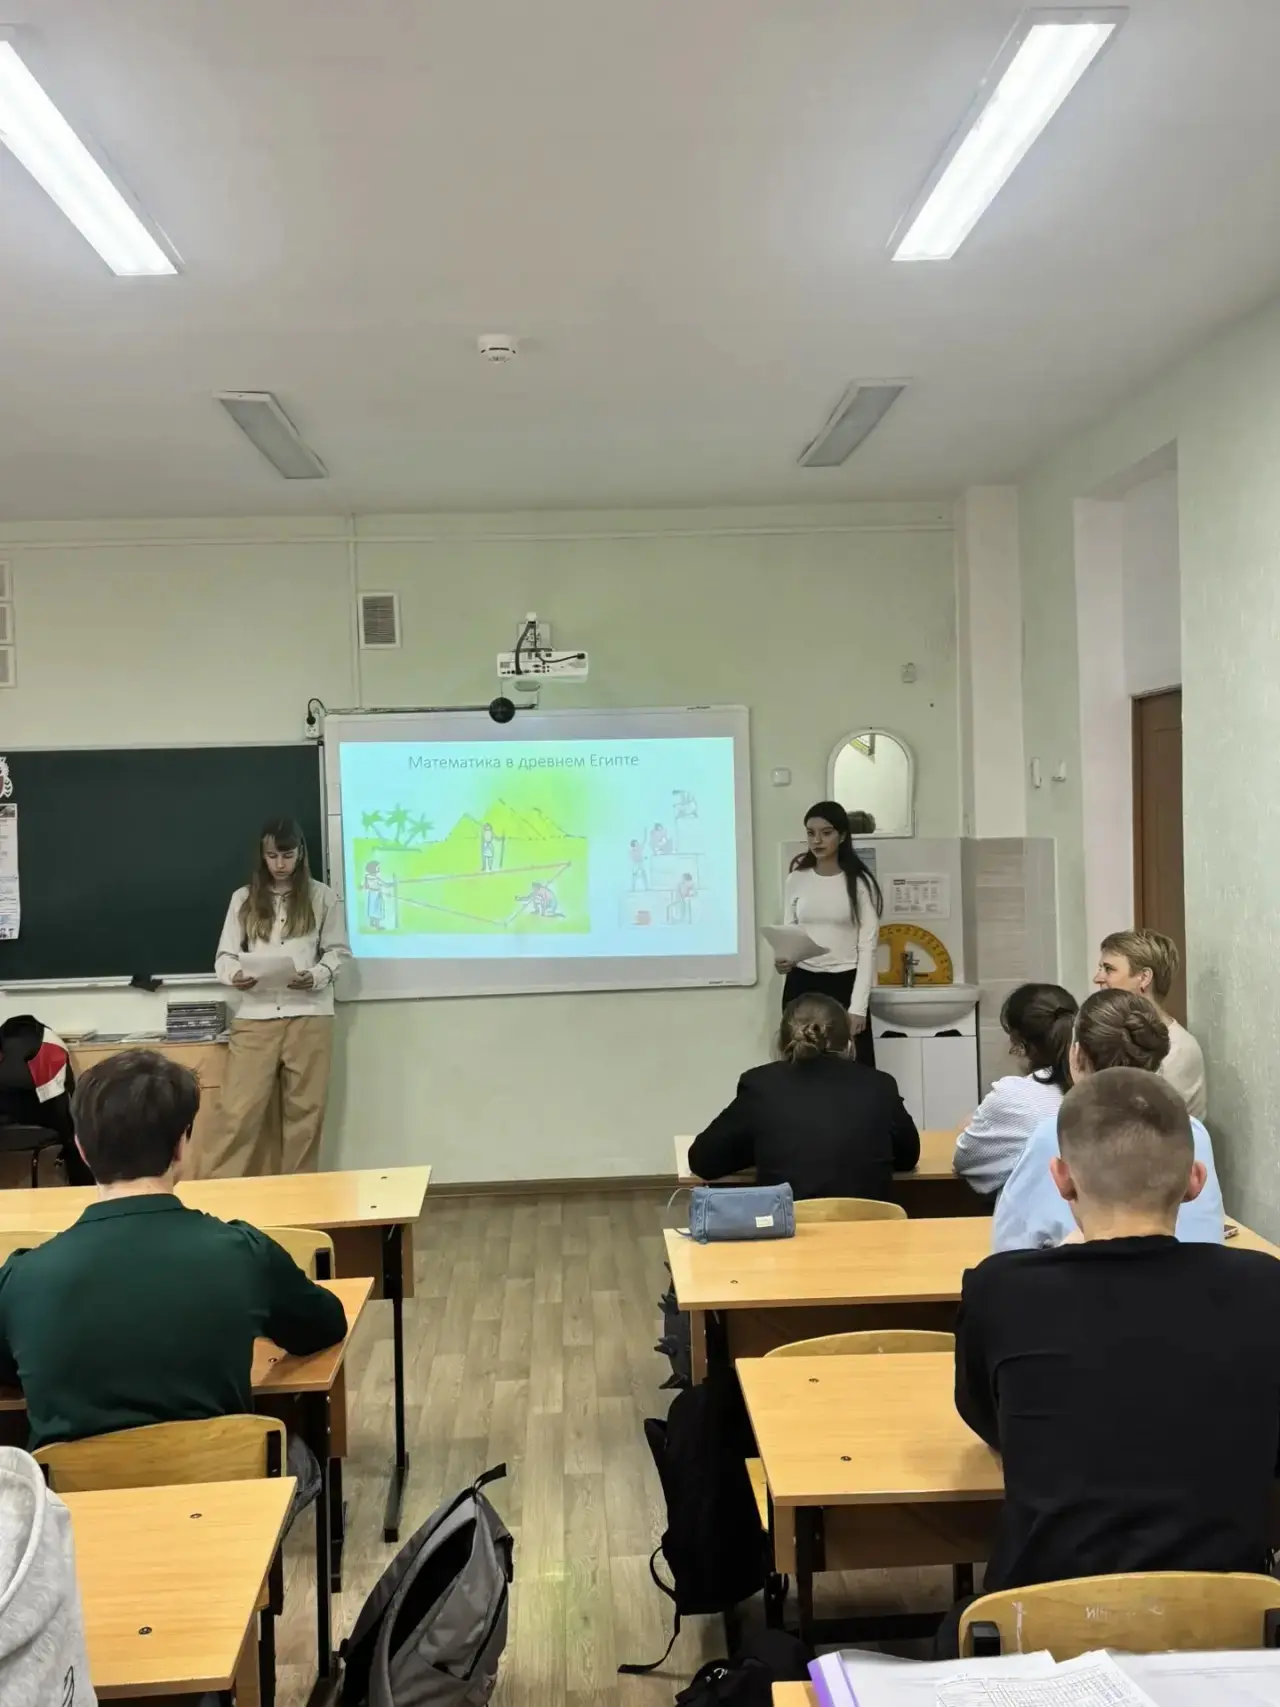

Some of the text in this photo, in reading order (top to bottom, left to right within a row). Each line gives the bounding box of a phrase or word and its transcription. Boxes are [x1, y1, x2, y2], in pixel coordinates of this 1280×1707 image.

[409, 754, 639, 771] Математика в древнем Египте
